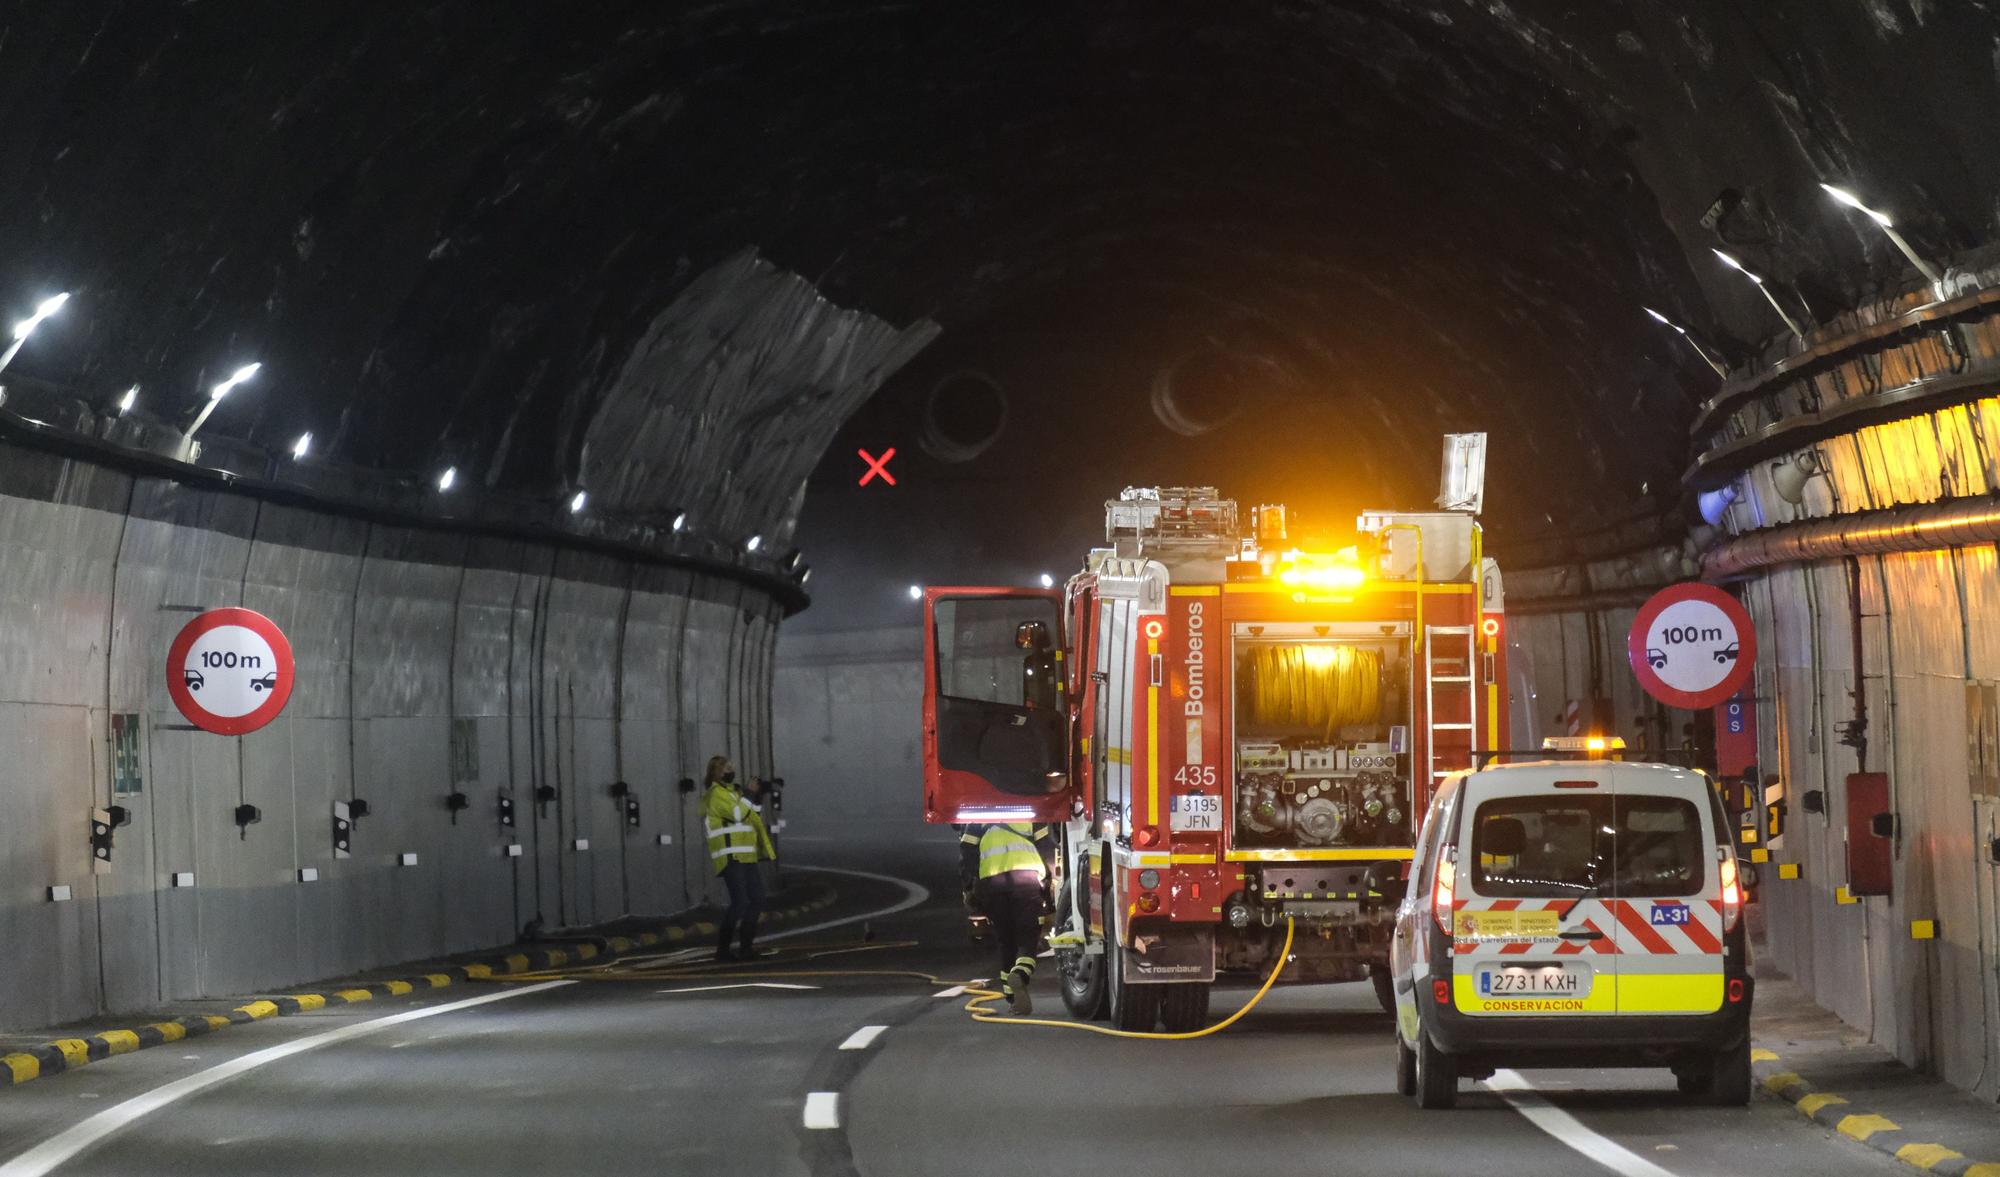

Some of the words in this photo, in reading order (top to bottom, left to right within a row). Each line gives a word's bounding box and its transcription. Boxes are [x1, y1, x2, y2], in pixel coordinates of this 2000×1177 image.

[1184, 601, 1204, 716] Bomberos
[1174, 766, 1216, 786] 435
[1183, 799, 1218, 812] 3195
[1185, 815, 1210, 828] JFN
[1653, 909, 1688, 922] A-31
[1470, 936, 1479, 944] de
[1481, 936, 1518, 944] Carreteras
[1521, 936, 1532, 944] del
[1534, 936, 1559, 944] Estado
[1494, 975, 1536, 990] 2731
[1544, 975, 1577, 990] KXH
[1483, 1000, 1583, 1011] CONSERVACIÓN
